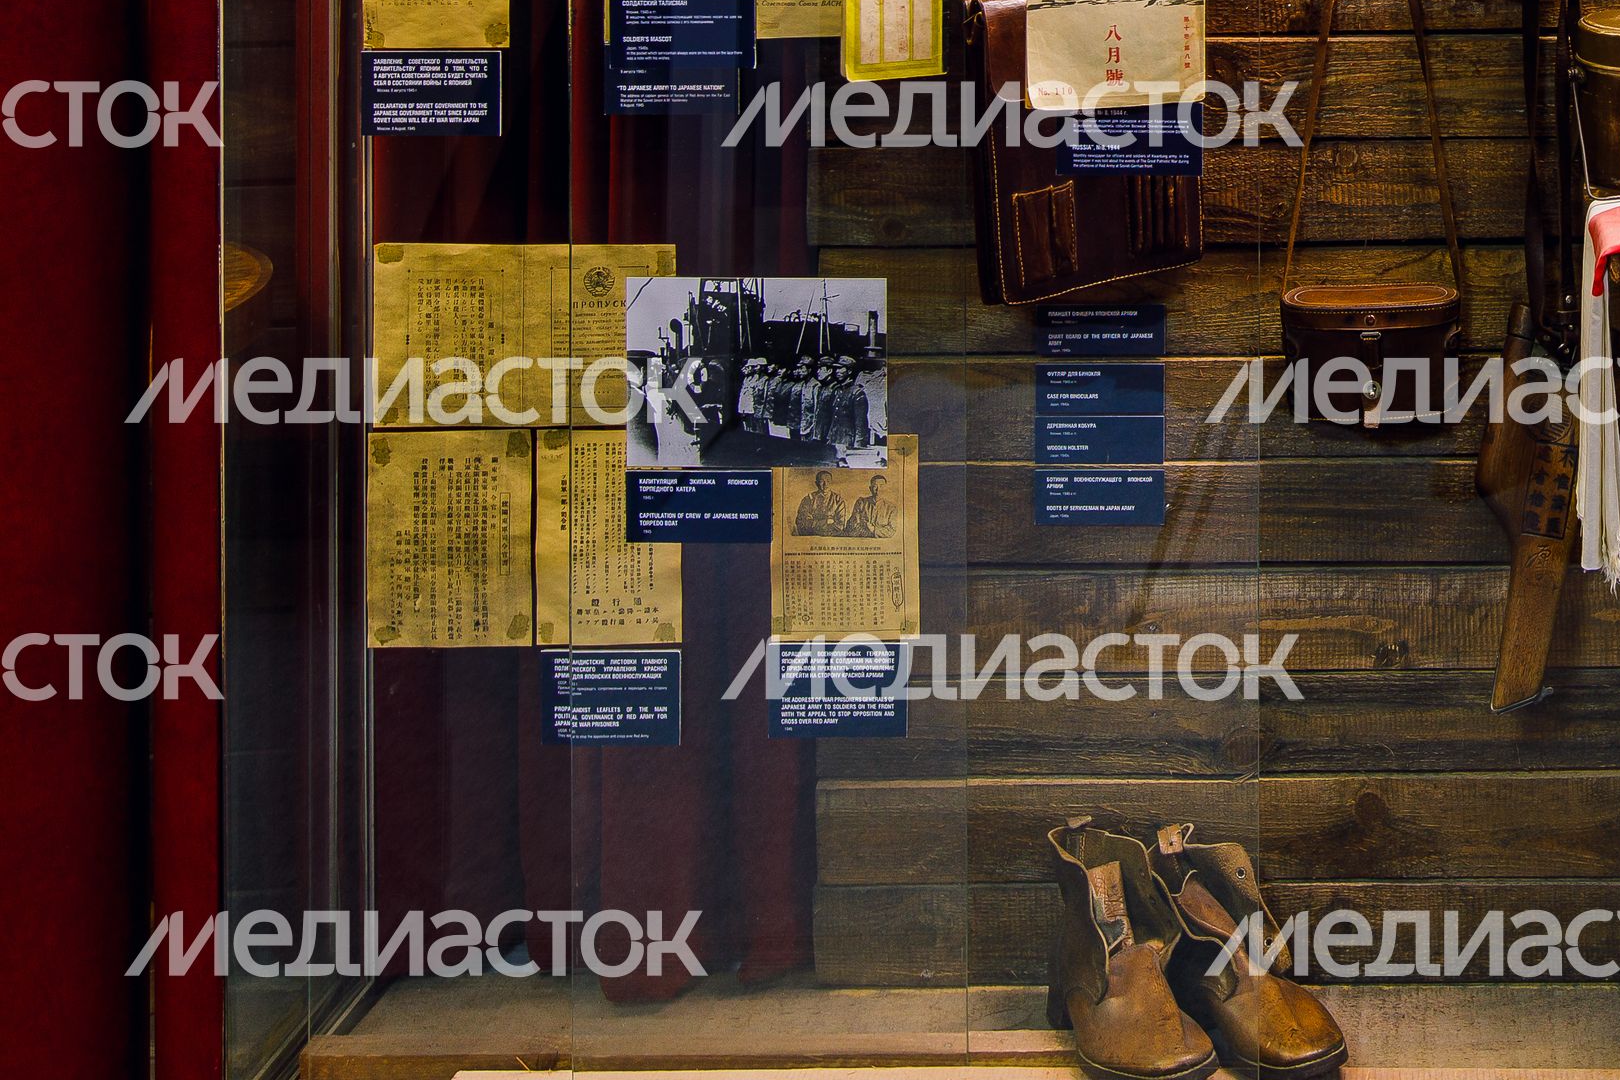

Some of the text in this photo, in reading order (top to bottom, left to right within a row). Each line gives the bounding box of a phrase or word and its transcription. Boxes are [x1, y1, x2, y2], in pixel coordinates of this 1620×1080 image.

[622, 0, 658, 7] СОЛДАТСКИЙ
[1055, 86, 1072, 96] 110
[572, 301, 627, 309] ПРОПУСК
